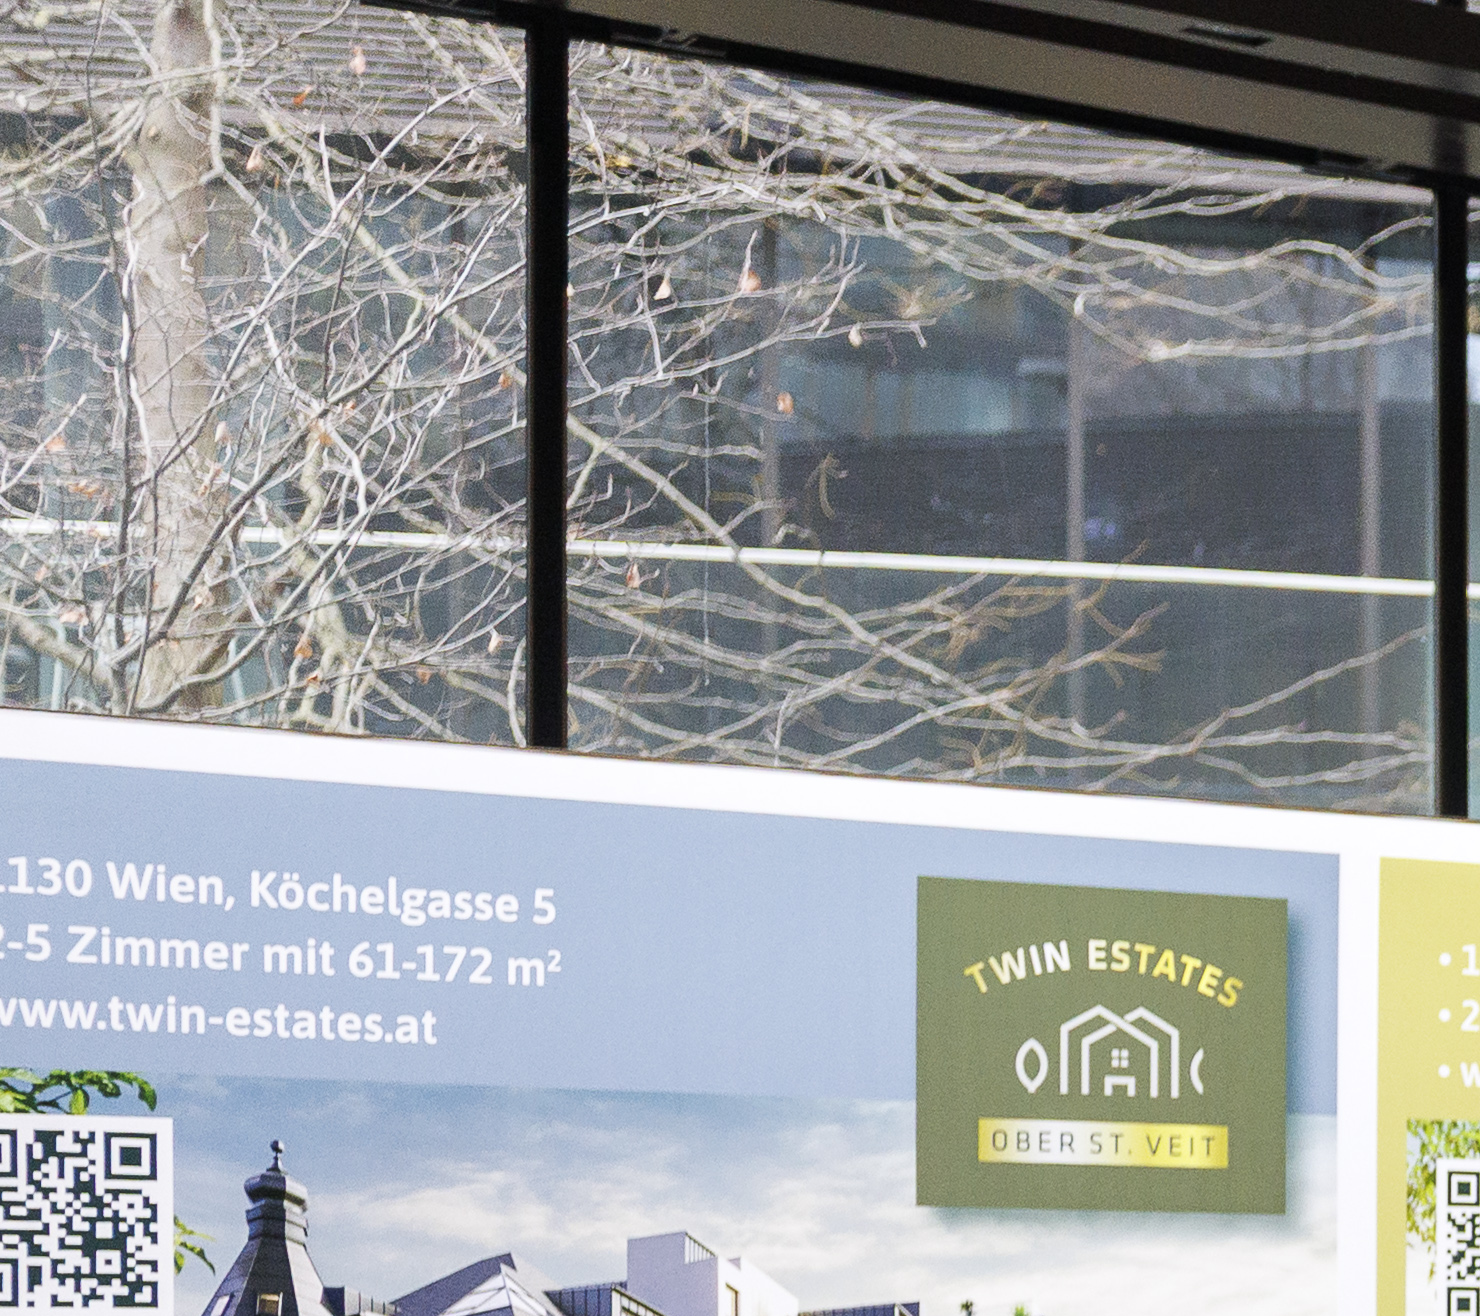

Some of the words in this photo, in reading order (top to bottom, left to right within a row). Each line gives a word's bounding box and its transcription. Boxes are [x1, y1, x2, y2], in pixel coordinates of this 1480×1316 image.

[106, 861, 236, 912] Wien,
[250, 870, 519, 926] Köchelgasse
[532, 888, 557, 924] 5
[0, 923, 52, 961] -5
[66, 925, 249, 971] Zimmer
[263, 938, 336, 976] mit
[347, 941, 494, 985] 61-172
[507, 950, 562, 986] m²
[963, 939, 1072, 994] TWIN
[1088, 938, 1244, 1008] ESTATES
[992, 1129, 1075, 1154] OBER
[1089, 1132, 1133, 1156] ST.
[1146, 1134, 1216, 1158] VEIT
